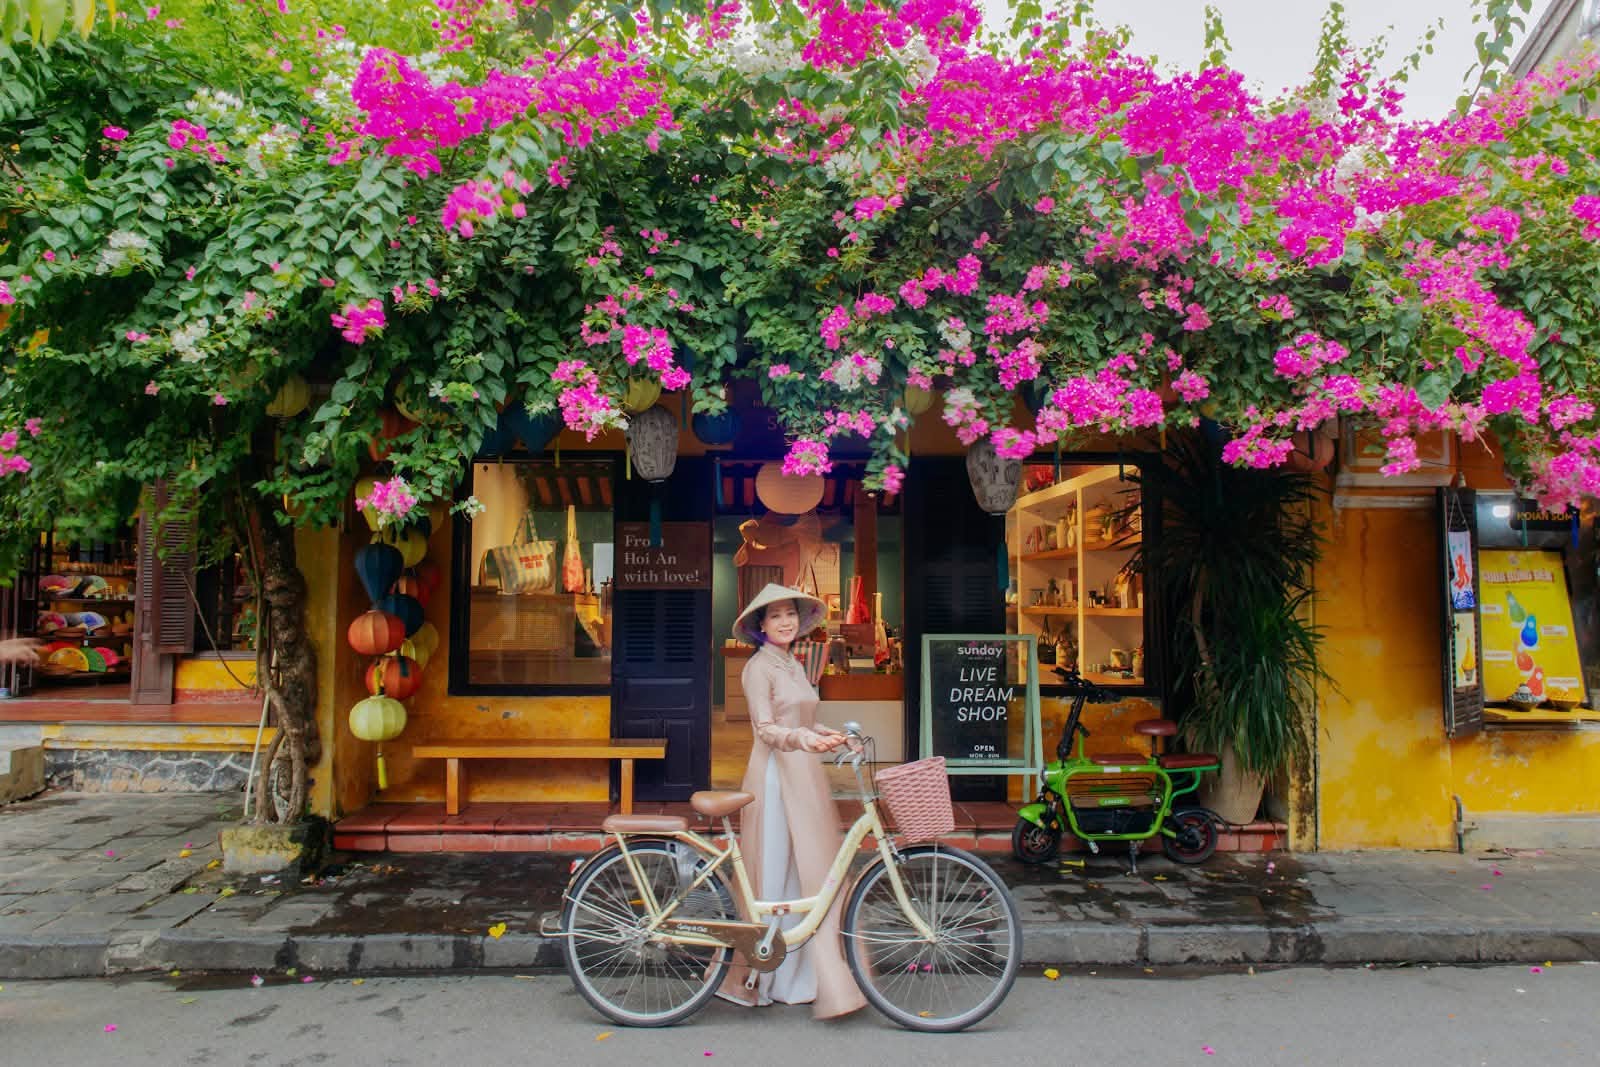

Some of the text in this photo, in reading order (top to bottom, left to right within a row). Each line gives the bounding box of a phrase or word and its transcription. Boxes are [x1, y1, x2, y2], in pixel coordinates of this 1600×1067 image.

[624, 534, 665, 547] Fro
[624, 552, 677, 565] Hoi An
[624, 569, 699, 582] with love!
[957, 644, 1003, 658] sunday
[960, 667, 997, 682] LIVE
[949, 687, 1017, 703] DREAM.
[957, 706, 1008, 722] SHOP.
[974, 744, 995, 752] OPEN
